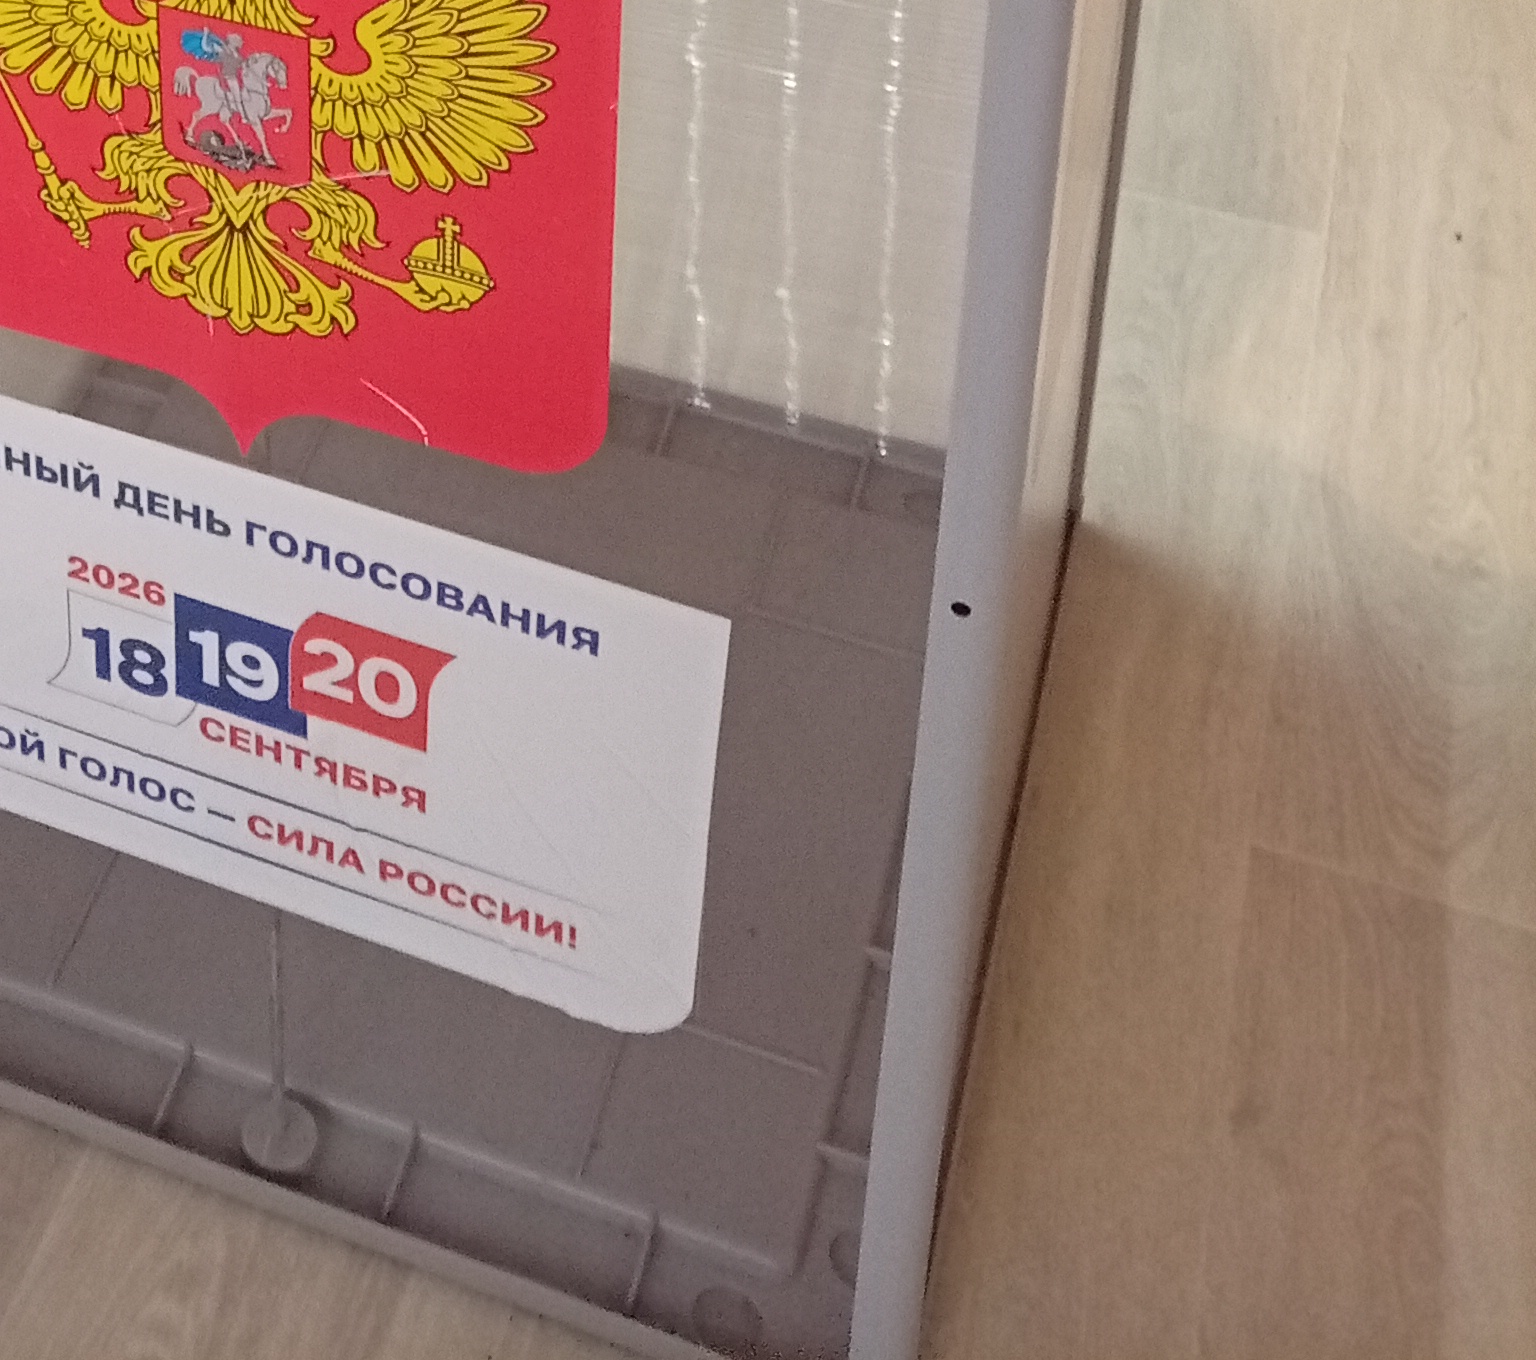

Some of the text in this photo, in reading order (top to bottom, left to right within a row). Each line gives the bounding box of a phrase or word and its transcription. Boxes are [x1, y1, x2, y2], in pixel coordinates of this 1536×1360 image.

[67, 555, 166, 607] 2026
[113, 480, 232, 538] ДЕНЬ
[244, 519, 601, 657] ГОЛОСОВАНИЯ
[81, 626, 418, 720] 18 19 20
[199, 716, 427, 814] СЕНТЯБРЯ
[58, 746, 196, 813] ГОЛОС
[247, 813, 366, 874] СИЛА
[378, 858, 577, 950] РОССИИ!
